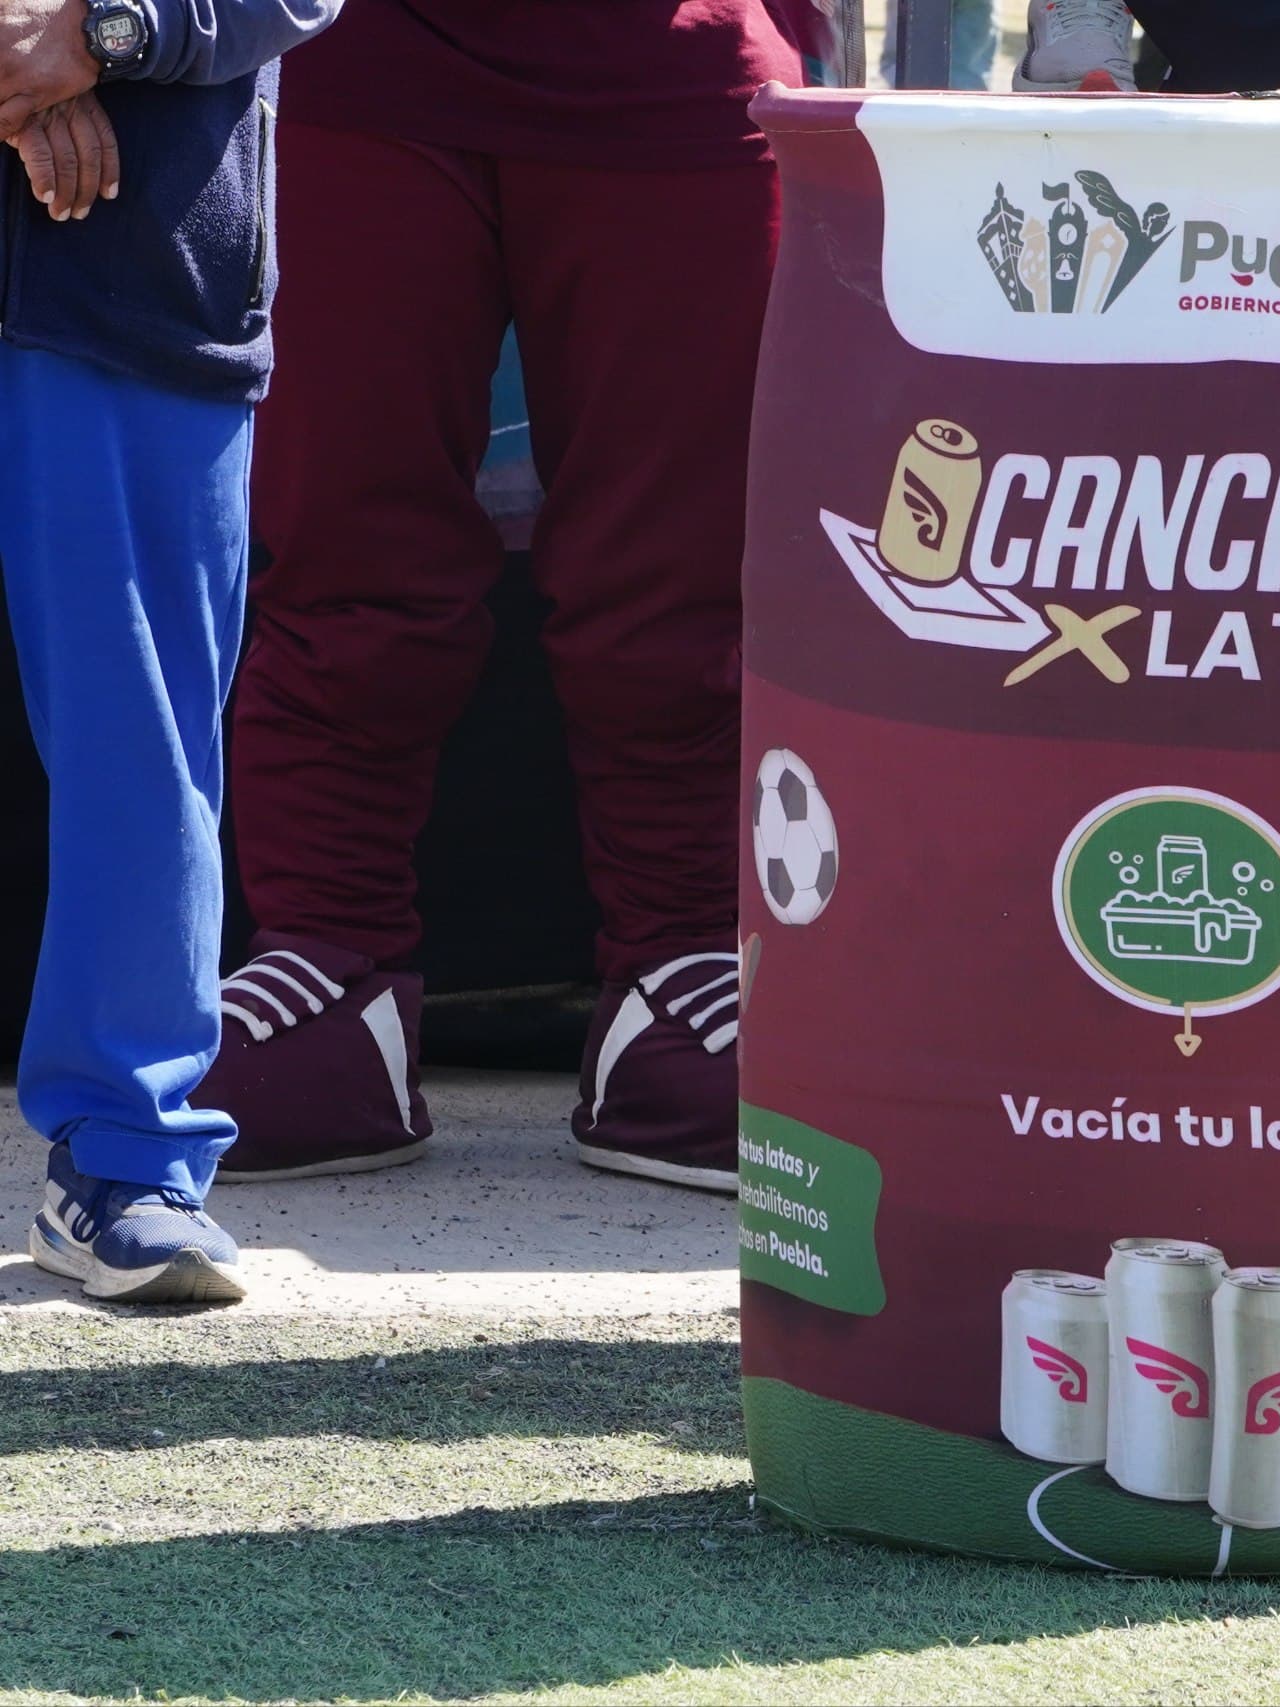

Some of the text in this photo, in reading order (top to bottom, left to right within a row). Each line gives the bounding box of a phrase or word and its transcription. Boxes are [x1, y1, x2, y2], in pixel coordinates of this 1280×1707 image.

[1004, 603, 1142, 687] X
[1000, 1094, 1162, 1143] Vacía
[1174, 1106, 1234, 1147] tu
[749, 1138, 764, 1165] tus
[766, 1139, 804, 1177] latas
[806, 1163, 820, 1188] y
[742, 1179, 829, 1231] rehabilitemos
[754, 1231, 767, 1254] en
[769, 1230, 829, 1277] Puebla.
